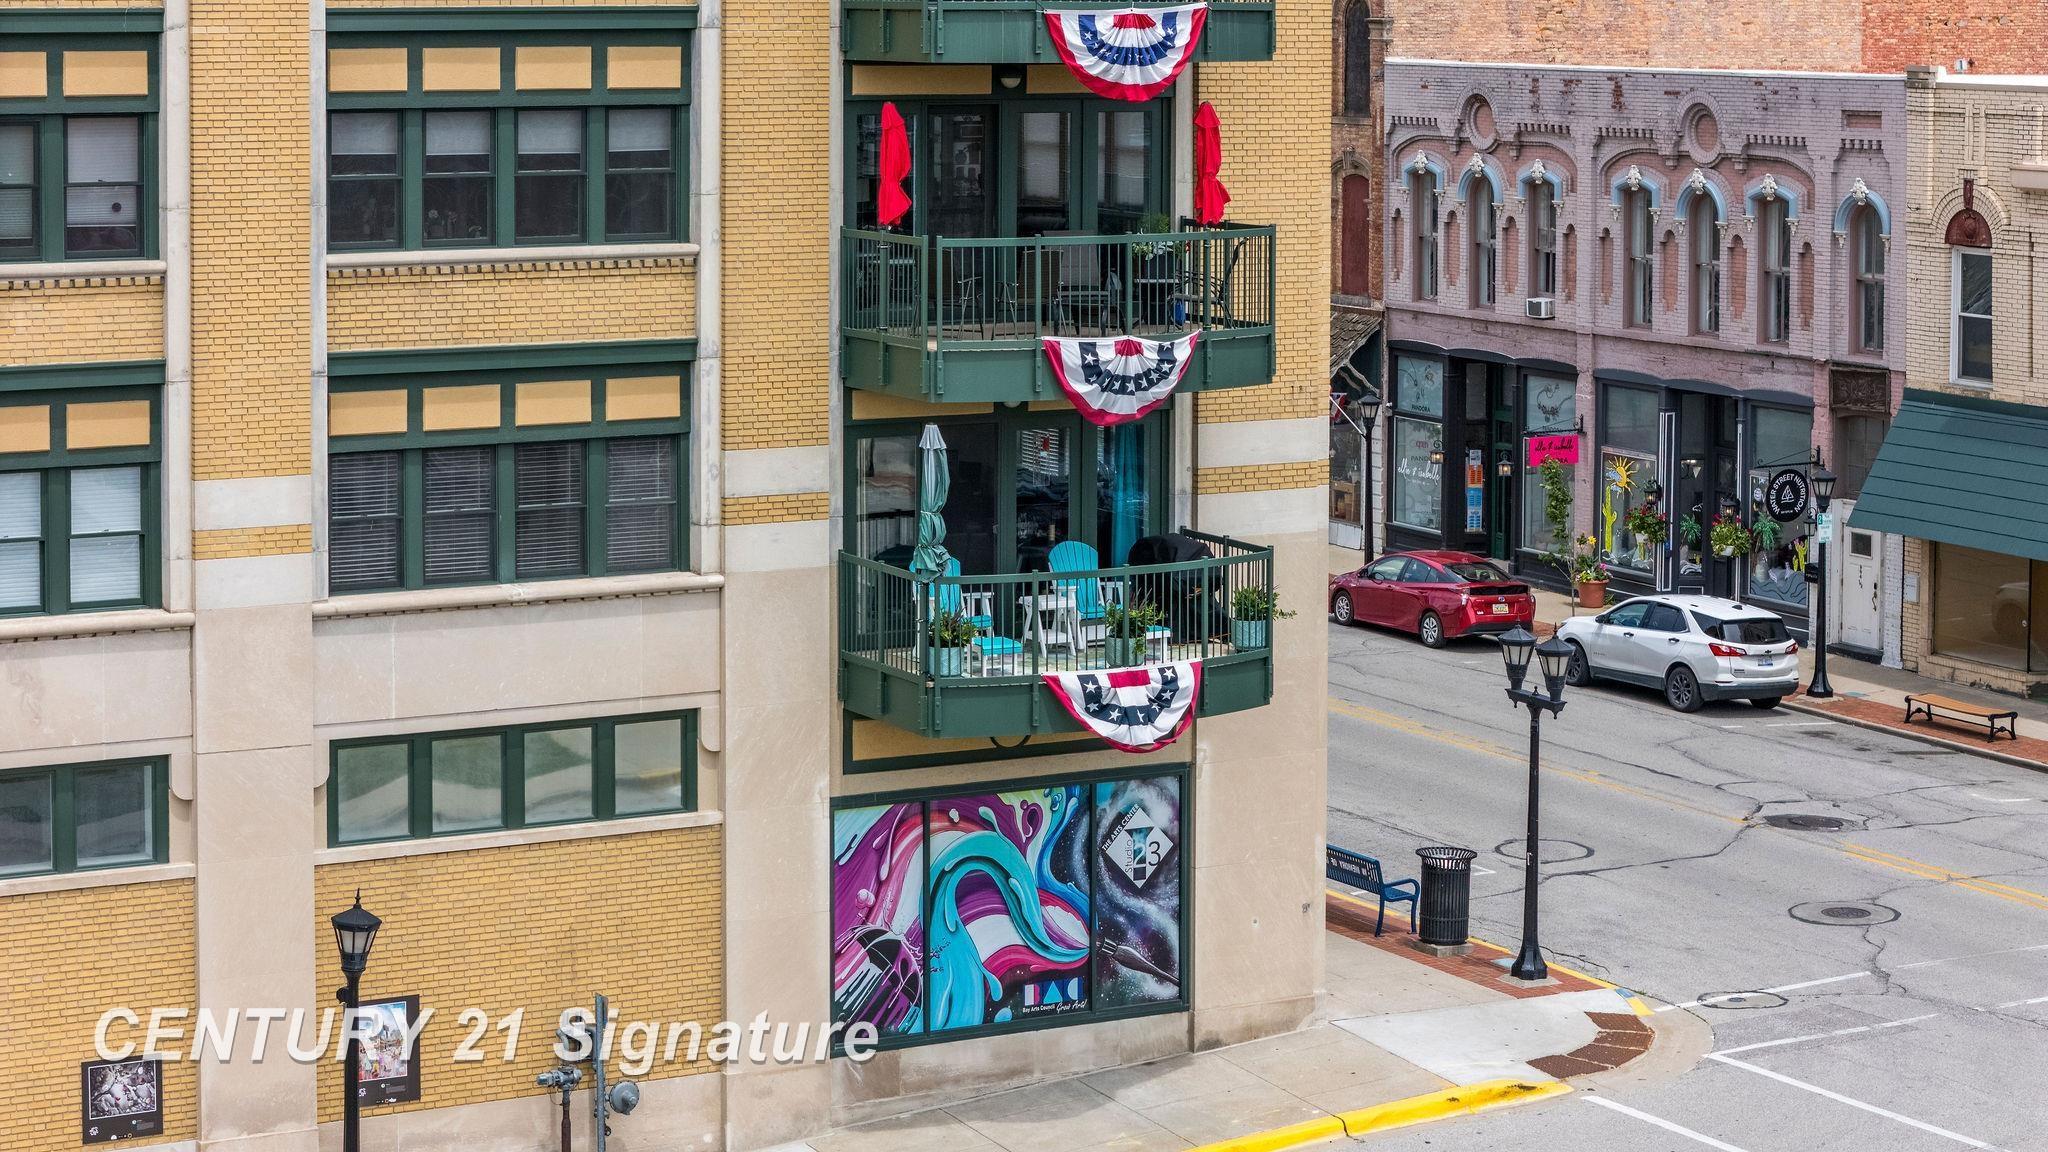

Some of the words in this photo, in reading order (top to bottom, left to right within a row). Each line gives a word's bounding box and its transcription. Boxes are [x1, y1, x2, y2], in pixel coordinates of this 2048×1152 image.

[1773, 473, 1795, 489] STREET
[1794, 475, 1806, 512] NUTRITION
[1770, 489, 1780, 514] WATER
[1102, 838, 1112, 851] THE
[1111, 825, 1123, 840] ARTS
[1121, 803, 1140, 826] CENTER
[1125, 839, 1133, 873] Studio
